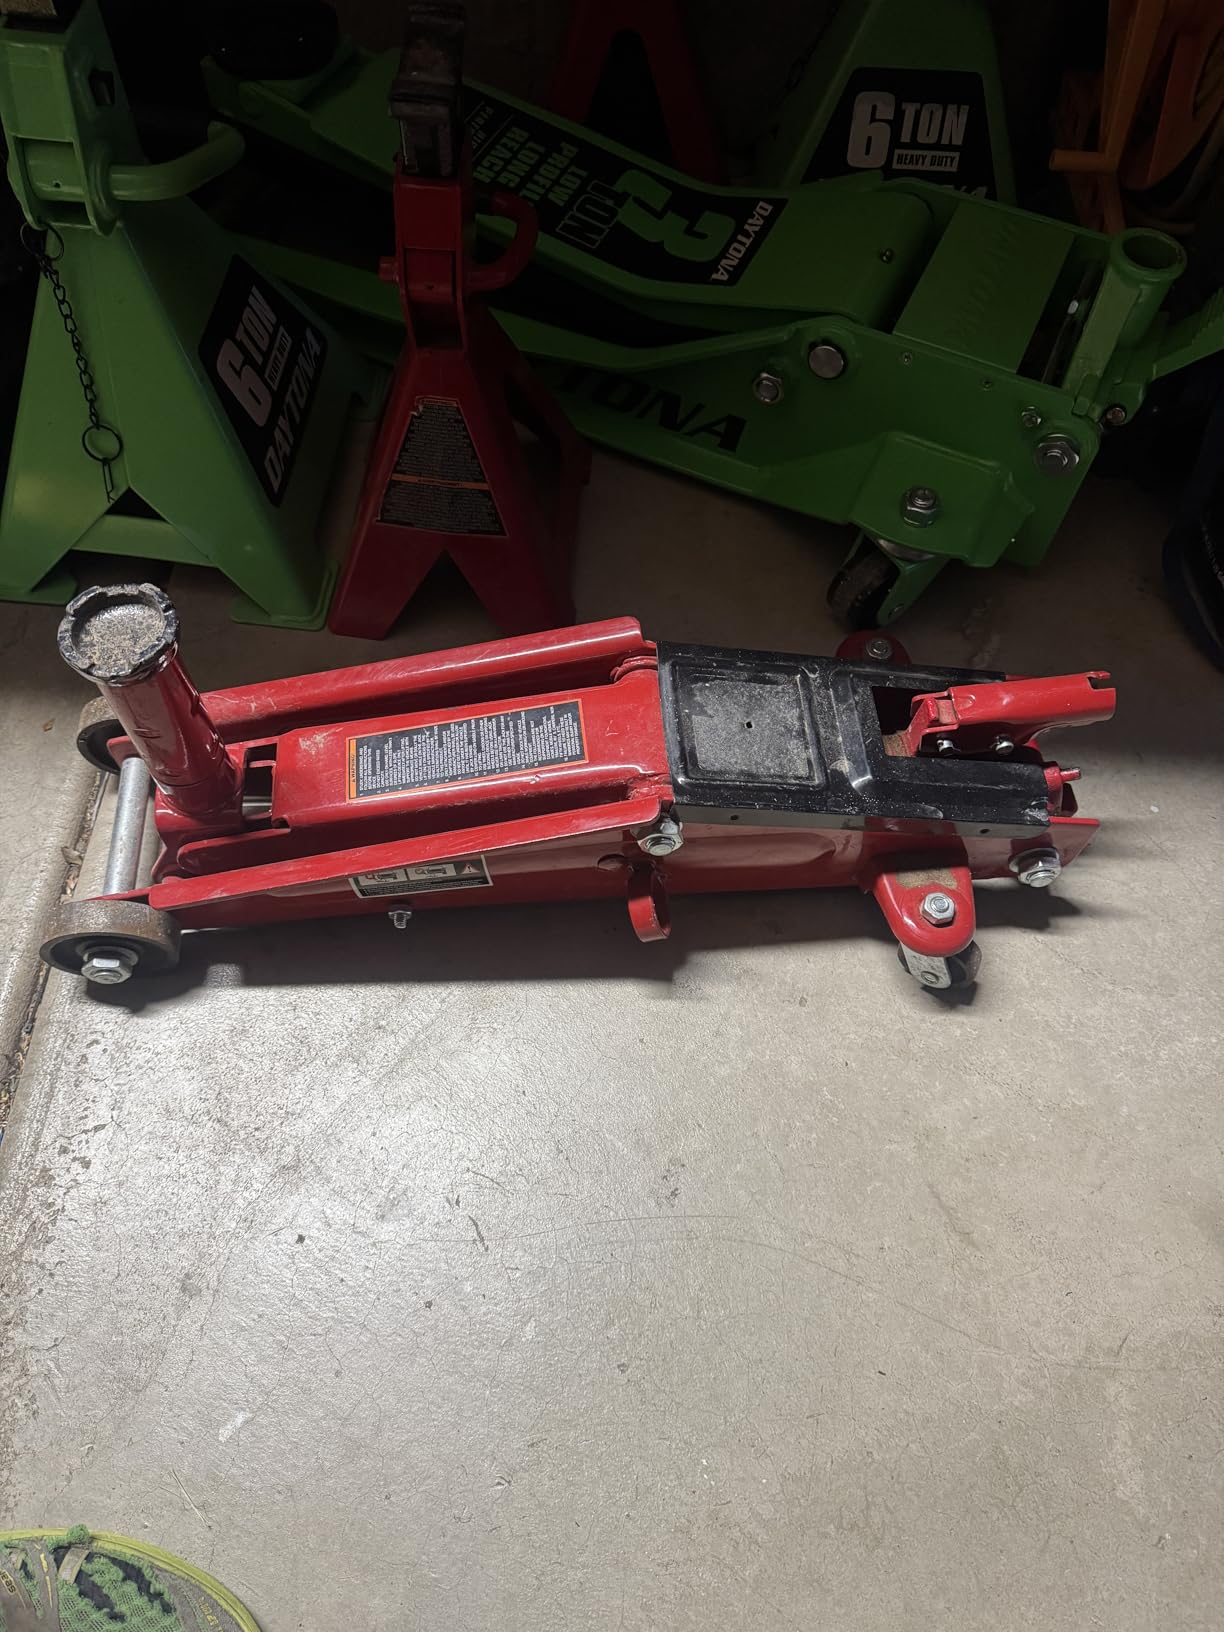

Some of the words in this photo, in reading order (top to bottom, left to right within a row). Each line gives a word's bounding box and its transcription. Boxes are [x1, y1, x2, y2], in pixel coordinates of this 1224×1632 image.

[473, 126, 529, 183] REACH
[497, 141, 547, 188] LONG
[846, 91, 896, 168] 6
[899, 102, 970, 145] TON
[896, 153, 927, 167] HEAVY
[929, 156, 956, 168] DUTY
[519, 141, 580, 207] PROFIL
[547, 165, 589, 207] LOW
[555, 179, 620, 248] TON
[615, 169, 736, 262] 3
[711, 200, 774, 281] DAYTONA
[235, 285, 277, 366] TON
[216, 337, 272, 427] 6
[263, 328, 320, 494] DAYTONA
